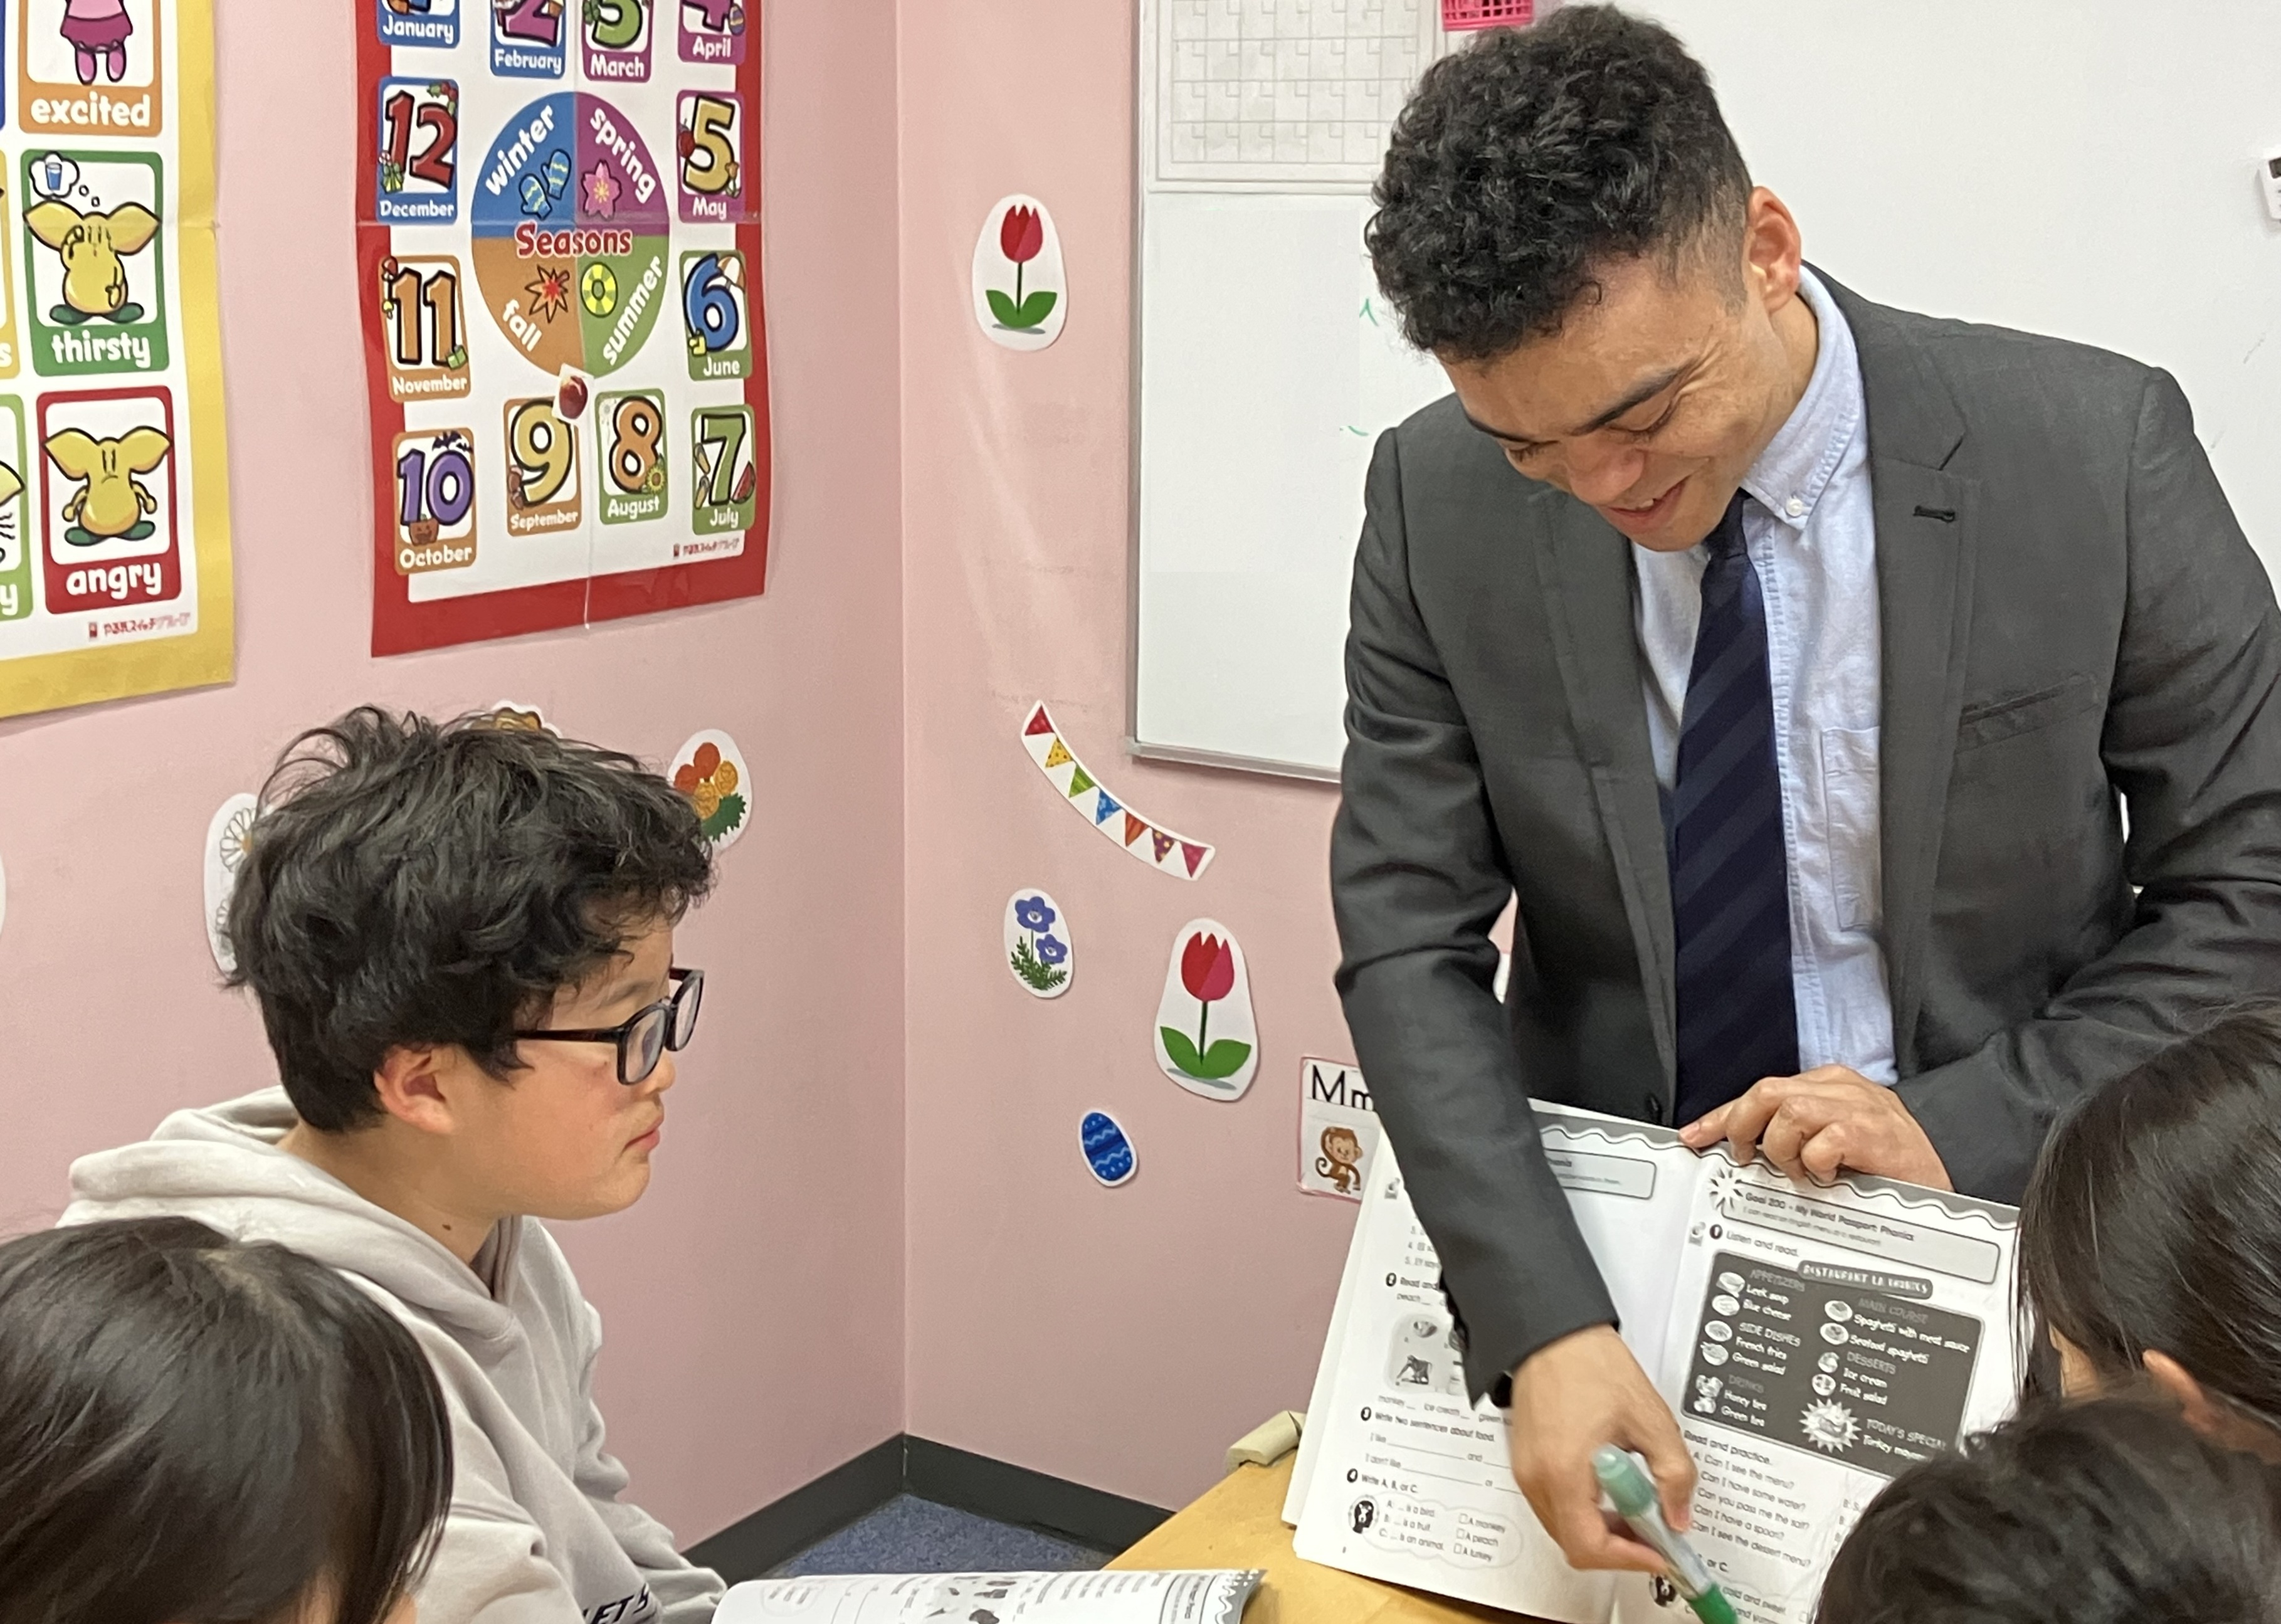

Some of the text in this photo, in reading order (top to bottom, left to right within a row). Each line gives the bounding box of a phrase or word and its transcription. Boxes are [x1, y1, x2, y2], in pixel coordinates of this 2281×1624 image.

[382, 15, 454, 44] January
[693, 36, 731, 60] April
[495, 49, 562, 75] February
[591, 54, 644, 78] March
[31, 92, 150, 127] excited
[385, 89, 458, 189] 12
[486, 105, 554, 195] winter
[683, 96, 735, 193] 5
[591, 108, 656, 203] spring
[381, 199, 454, 218] December
[693, 199, 726, 220] May
[516, 223, 631, 257] Seasons
[603, 256, 662, 366] summer
[684, 253, 739, 351] 6
[390, 268, 458, 366] 11
[503, 299, 542, 352] fall
[52, 330, 150, 369] thirsty
[704, 357, 740, 376] June
[392, 374, 468, 395] November
[511, 399, 572, 507] 9
[609, 396, 663, 494] 8
[701, 413, 747, 506] 7
[397, 448, 475, 526] 10
[510, 509, 578, 530] September
[608, 499, 661, 519] August
[710, 509, 739, 528] July
[400, 544, 472, 568] October
[66, 562, 162, 600] angry
[1312, 1065, 1370, 1110] Mm
[1727, 1230, 1752, 1244] Listen
[1754, 1240, 1773, 1250] and
[1739, 1322, 1763, 1336] SIDE
[1899, 1326, 1917, 1339] with
[1736, 1336, 1764, 1353] French
[1732, 1352, 1786, 1375] Green salad
[1846, 1351, 1896, 1374] DESSERTS
[1860, 1374, 1887, 1388] cream
[1840, 1383, 1887, 1405] Fruit salad
[1720, 1405, 1748, 1421] Green
[1450, 1427, 1473, 1438] about
[1684, 1430, 1708, 1445] Read
[1710, 1440, 1729, 1452] and
[1467, 1453, 1482, 1462] and
[1704, 1454, 1723, 1467] Can
[1725, 1460, 1730, 1470] I
[1732, 1464, 1747, 1475] see
[1749, 1468, 1762, 1480] the
[1765, 1475, 1794, 1489] menu?
[1700, 1470, 1720, 1484] Can
[1722, 1477, 1726, 1487] I
[1728, 1480, 1750, 1494] have
[1752, 1489, 1776, 1502] some
[1694, 1504, 1713, 1517] Can
[1714, 1510, 1719, 1520] I
[1720, 1513, 1743, 1527] have
[1745, 1522, 1752, 1531] a
[1697, 1487, 1716, 1499] Can
[1718, 1495, 1736, 1507] you
[1736, 1502, 1756, 1514] pass
[1758, 1508, 1773, 1519] me
[1775, 1513, 1789, 1524] the
[1406, 1536, 1416, 1544] an
[1711, 1526, 1716, 1536] I
[1717, 1531, 1733, 1542] see
[1735, 1535, 1749, 1547] the
[1751, 1542, 1781, 1558] dessert
[1782, 1553, 1811, 1567] menu?
[1707, 1559, 1717, 1568] or
[1743, 1593, 1761, 1606] and
